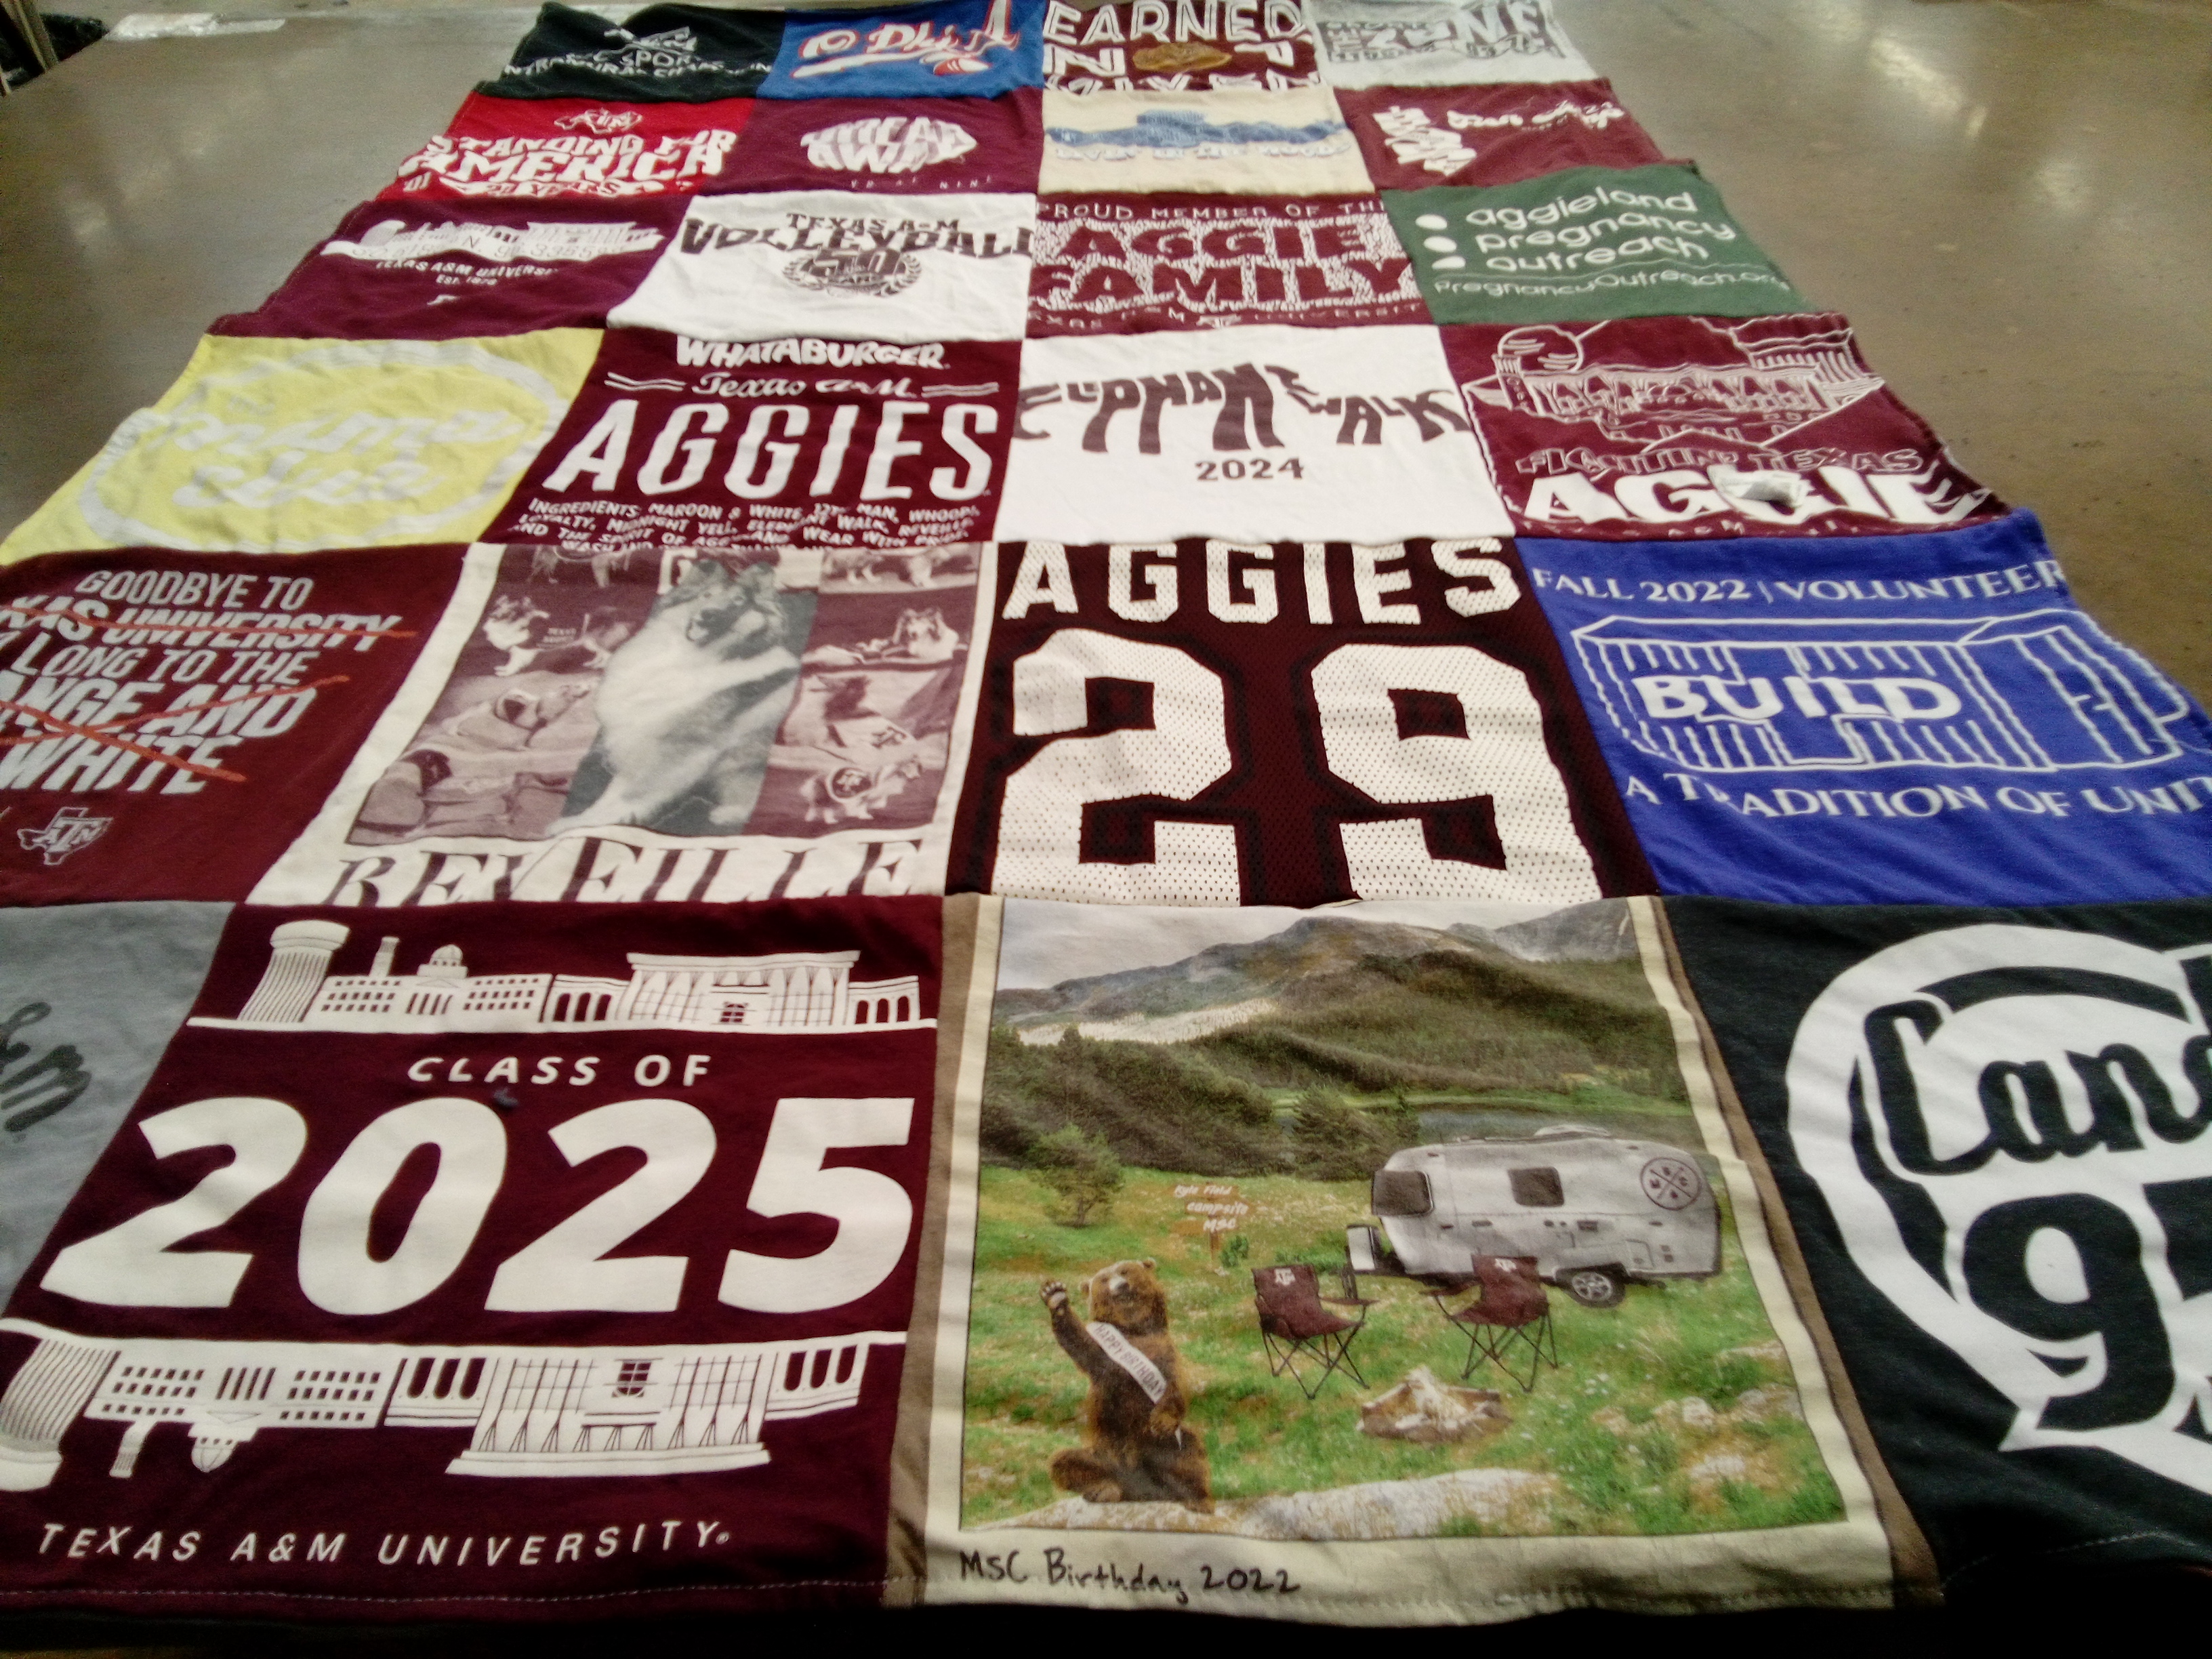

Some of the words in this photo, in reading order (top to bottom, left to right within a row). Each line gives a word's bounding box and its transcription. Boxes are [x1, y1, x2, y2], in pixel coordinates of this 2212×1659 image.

[1042, 0, 1309, 45] EARNED
[397, 143, 724, 183] AMERICA
[786, 213, 887, 234] TEXAS
[1285, 203, 1320, 218] OF
[1466, 186, 1698, 230] aggieland
[1057, 223, 1368, 264] AGGIE
[1475, 212, 1736, 253] pregnancy
[1486, 234, 1709, 272] outreach
[1029, 257, 1412, 303] FAMILY
[676, 337, 945, 370] WHATABURGER
[691, 371, 807, 397] Texas
[541, 398, 999, 500] AGGIES
[1195, 457, 1305, 482] 2024
[648, 502, 724, 520] MAROON
[75, 570, 258, 609] GOODBYE
[260, 575, 313, 609] TO
[1001, 539, 1522, 626] AGGIES
[1532, 567, 1633, 602] FALL
[1639, 579, 1752, 602] 2022
[1774, 559, 2068, 603] VOLUNTEER
[0, 594, 110, 642] XAS
[102, 608, 402, 651] UNIVERSITY
[10, 632, 148, 678] LONG
[148, 648, 217, 682] TO
[218, 651, 320, 685] THE
[138, 684, 316, 738] AND
[1632, 675, 1963, 722] BUILD
[0, 733, 244, 794] WHITE
[990, 628, 1603, 907] 29
[1626, 776, 1662, 806] A
[1996, 786, 2071, 817] OF
[407, 1055, 600, 1087] CLASS
[634, 1054, 712, 1087] OF
[39, 1097, 914, 1316] 2025
[37, 1523, 201, 1563] TEXAS
[231, 1532, 347, 1565] A&M
[960, 1550, 1027, 1584] MSC
[1044, 1547, 1189, 1603] Birthday
[1200, 1565, 1300, 1594] 2022
